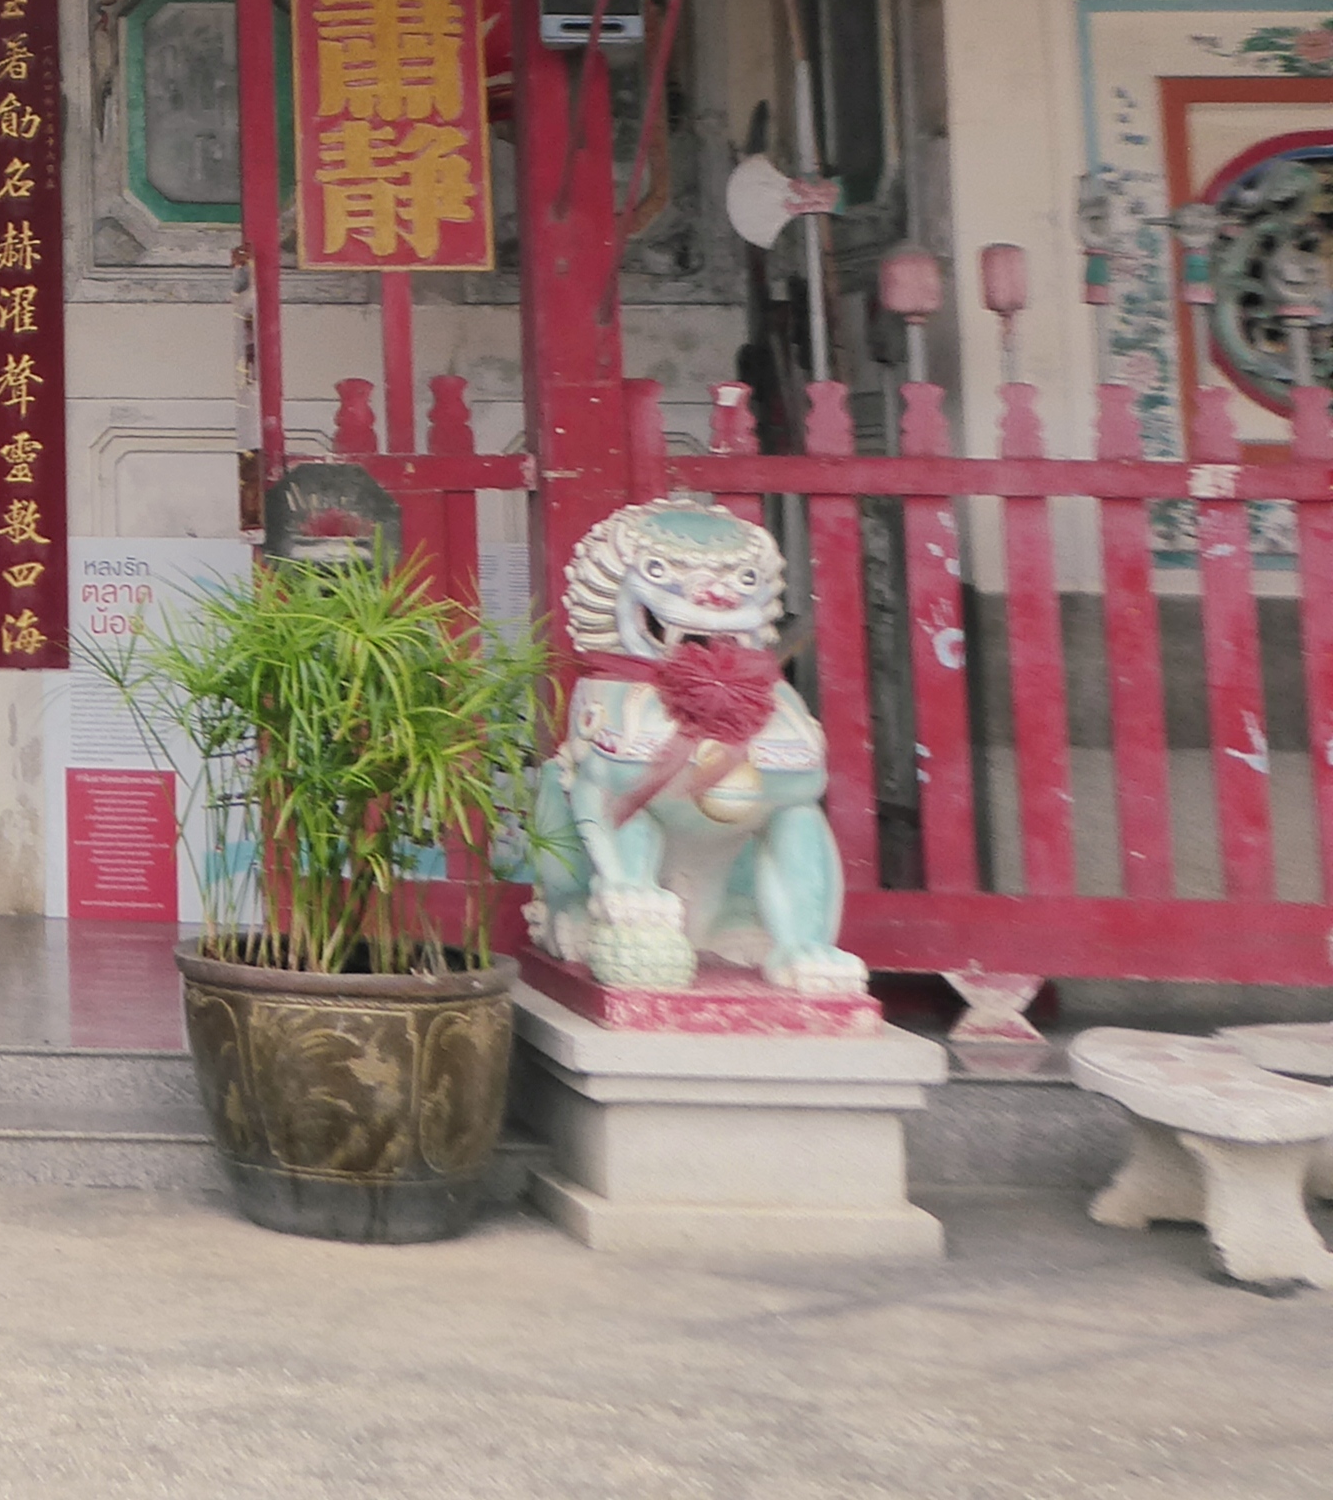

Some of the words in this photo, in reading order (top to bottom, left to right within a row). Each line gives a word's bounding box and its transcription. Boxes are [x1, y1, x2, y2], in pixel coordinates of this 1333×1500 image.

[83, 556, 150, 577] หลงรัก
[81, 583, 153, 605] ตลาด
